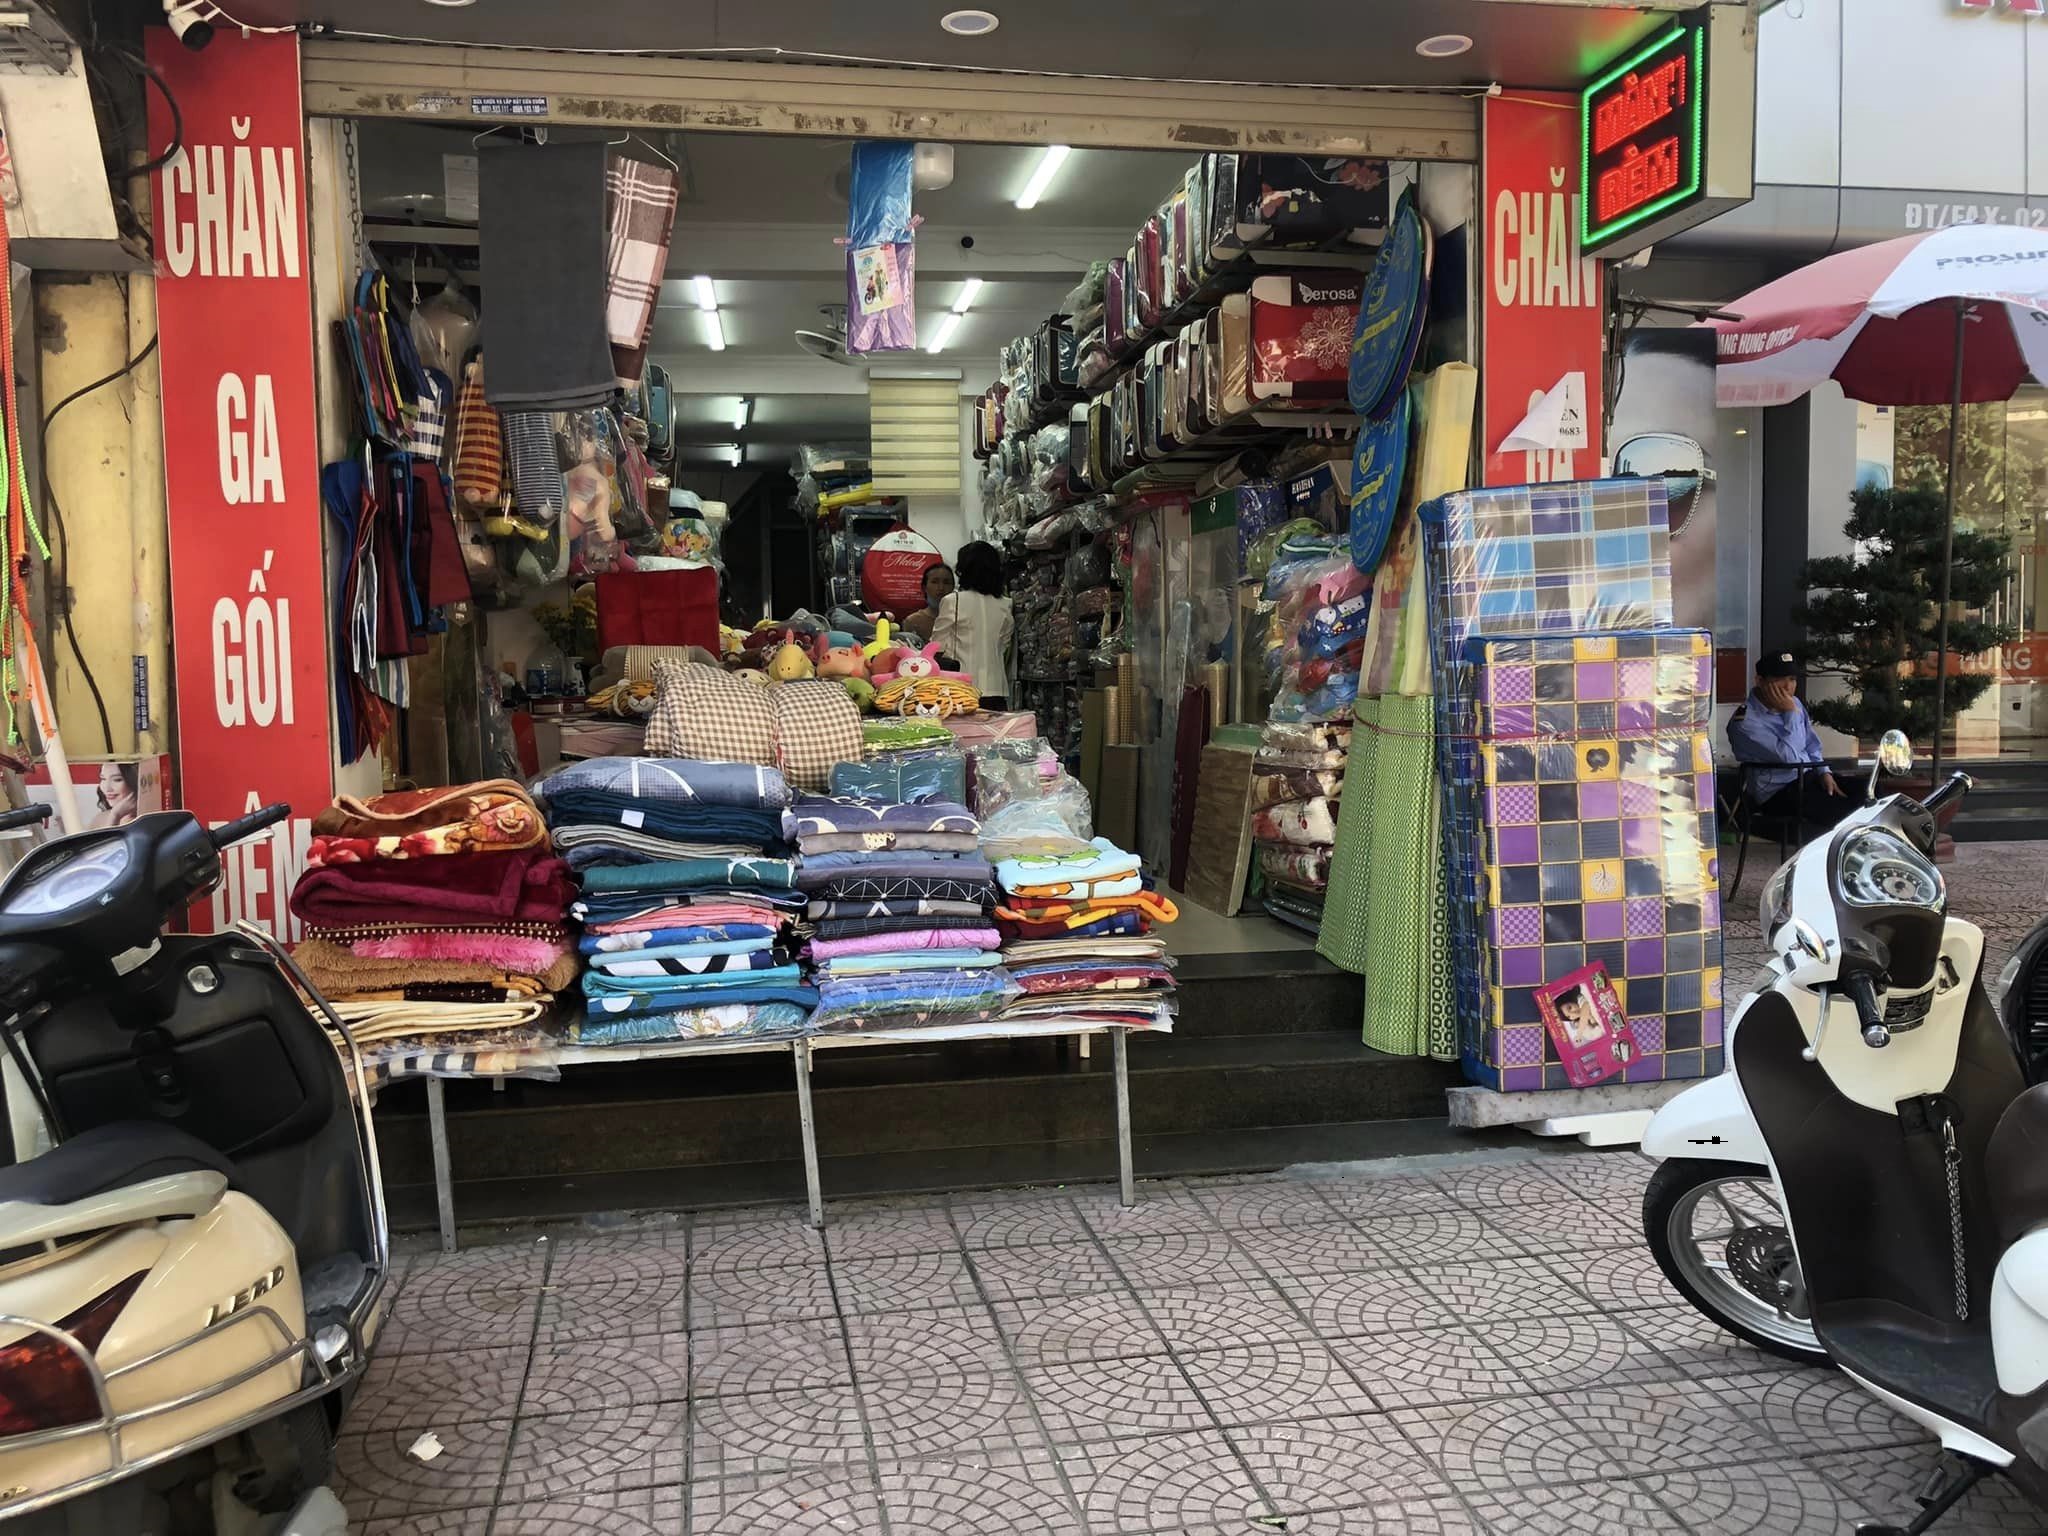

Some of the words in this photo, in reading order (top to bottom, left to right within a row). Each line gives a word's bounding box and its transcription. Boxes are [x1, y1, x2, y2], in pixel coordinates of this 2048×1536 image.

[162, 116, 300, 278] CHĂN
[1494, 167, 1597, 307] CHĂN
[1598, 143, 1678, 222] RÈM
[216, 372, 286, 505] GA
[212, 549, 295, 728] GỐI
